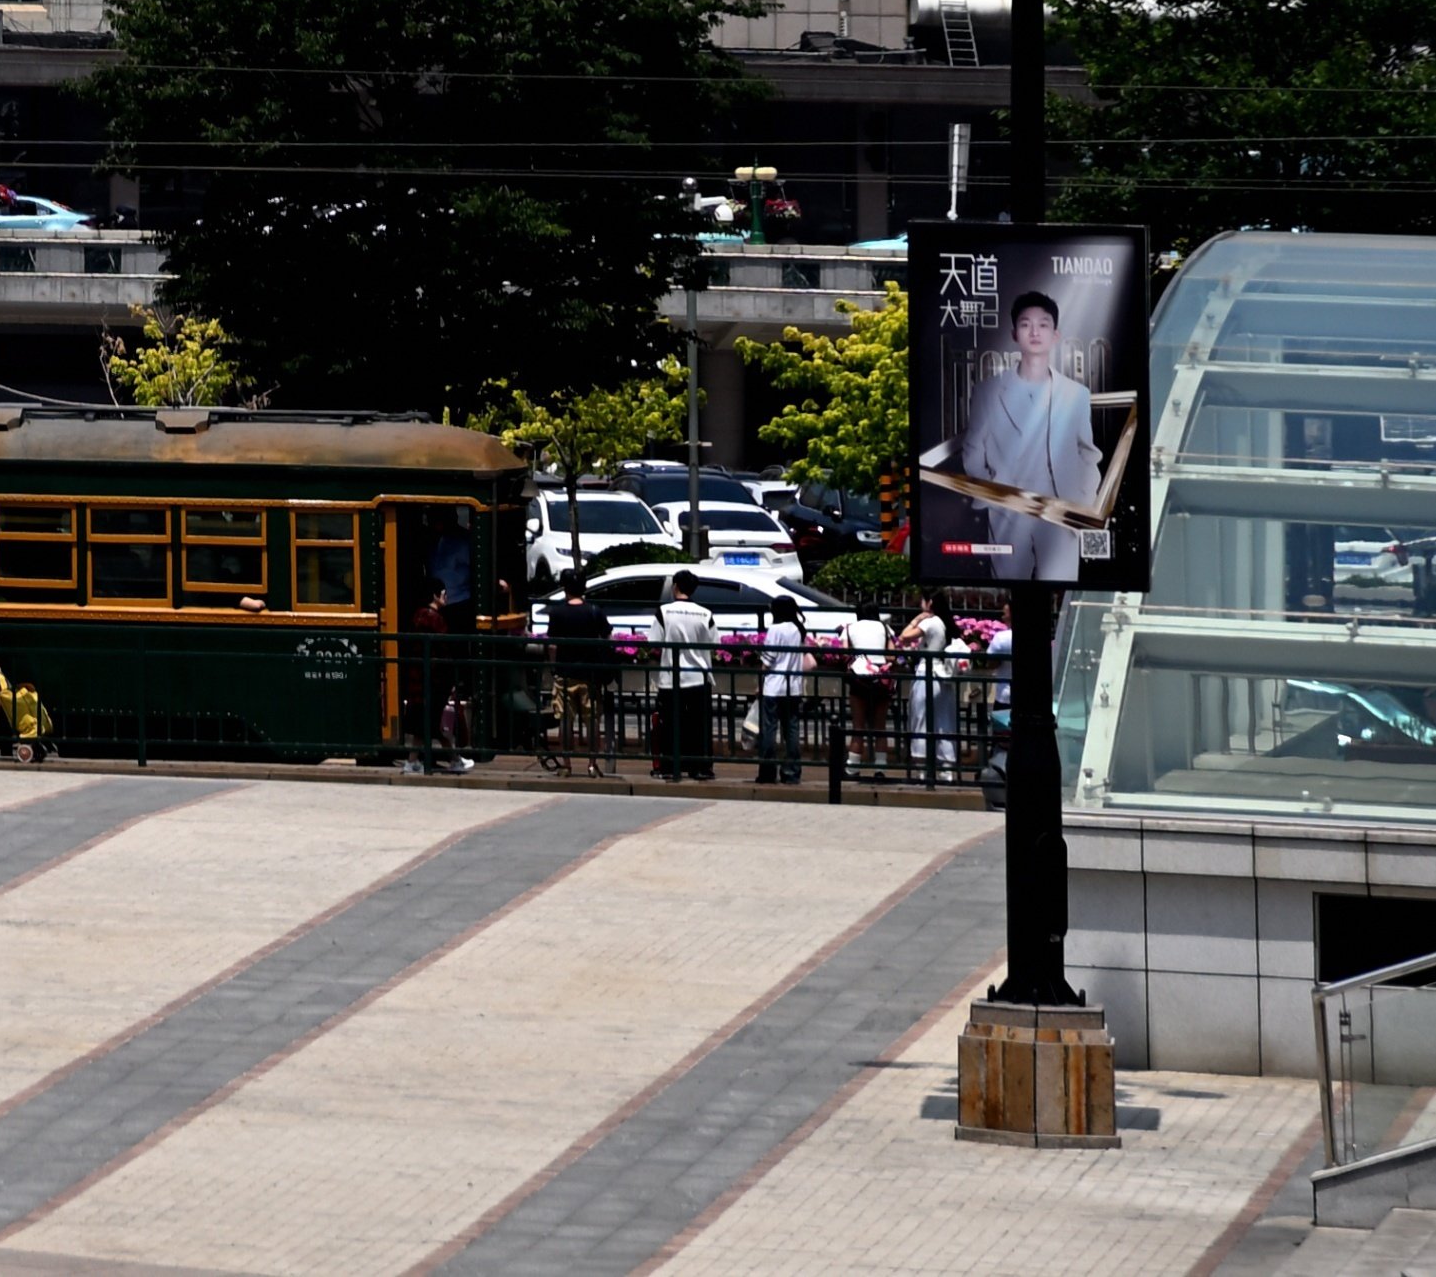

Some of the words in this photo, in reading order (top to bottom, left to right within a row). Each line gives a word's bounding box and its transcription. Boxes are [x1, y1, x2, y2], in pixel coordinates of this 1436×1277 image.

[940, 253, 998, 296] 天道
[1051, 256, 1113, 275] TIANDAO
[940, 299, 999, 335] 大舞台
